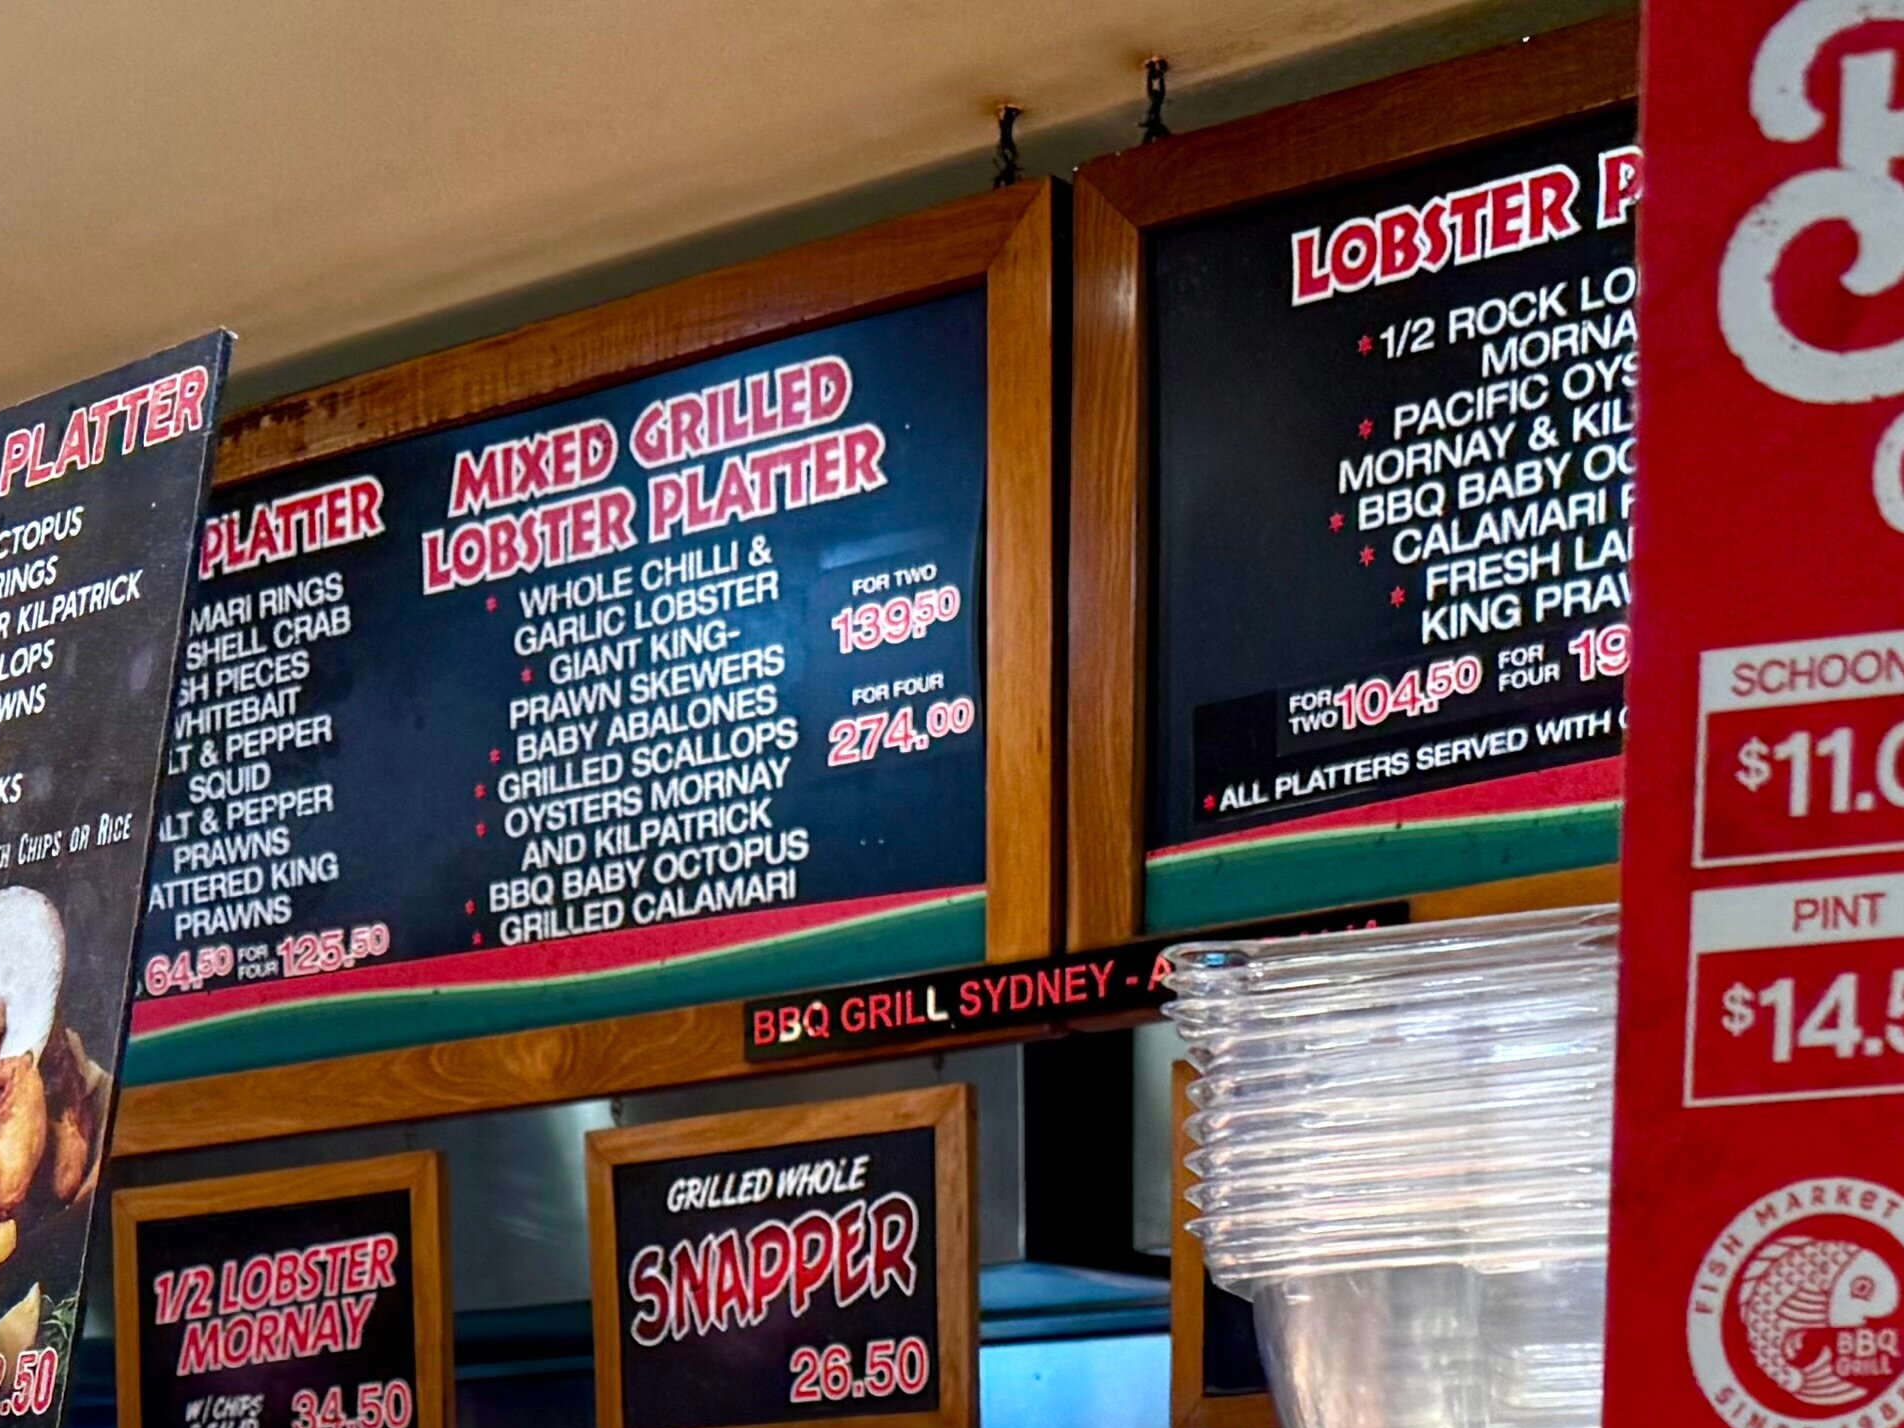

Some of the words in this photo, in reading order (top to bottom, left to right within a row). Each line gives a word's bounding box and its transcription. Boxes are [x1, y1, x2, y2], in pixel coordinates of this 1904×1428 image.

[1292, 163, 1580, 305] LOBSTER
[1379, 318, 1434, 359] 1/2
[1448, 283, 1566, 345] ROCK
[448, 420, 616, 517] MIXED
[631, 355, 852, 462] GRILLED
[1393, 374, 1549, 440] PACIFIC
[1339, 425, 1515, 494] MORNAY
[1358, 482, 1447, 532] BBQ
[1458, 453, 1570, 509] BABY
[199, 476, 385, 580] PLATTER
[422, 483, 635, 594] LOBSTER
[649, 425, 887, 543] PLATTER
[1392, 488, 1605, 564] CALAMARI
[17, 570, 142, 635] KILPATRICK
[519, 562, 636, 619] WHOLE
[642, 543, 742, 593] CHILLI
[746, 536, 773, 569] &
[1426, 537, 1560, 600] FRESH
[513, 609, 626, 657] GARLIC
[633, 572, 780, 629] LOBSTER
[830, 584, 962, 654] 139.50
[1421, 595, 1519, 645] KING
[509, 685, 623, 731] PRAWN
[629, 646, 786, 704] SKEWERS
[549, 642, 644, 685] GIANT
[1333, 657, 1482, 732] 104.50
[516, 725, 597, 765] BABY
[603, 686, 778, 749] ABALONES
[827, 696, 976, 768] 274.00
[1220, 778, 1269, 811] ALL
[1274, 752, 1409, 799] PLATTERS
[1416, 729, 1526, 772] SERVED
[1536, 709, 1610, 749] WITH
[488, 871, 553, 914] BBQ
[562, 856, 646, 899] BABY
[654, 829, 809, 884] OCTOPUS
[521, 833, 588, 872] AND
[594, 800, 773, 856] KILPATRICK
[1793, 892, 1885, 933] PINT
[752, 1002, 830, 1046] BBQ
[842, 986, 948, 1034] GRILL
[959, 960, 1116, 1017] SYDNEY
[666, 1166, 772, 1216] GRILLED
[776, 1155, 871, 1200] WHOLE
[153, 1262, 214, 1321] 1/2
[222, 1234, 399, 1316] LOBSTER
[629, 1191, 918, 1348] SNAPPER
[1694, 1234, 1744, 1314] FISH
[1755, 1185, 1900, 1227] MARKET
[177, 1296, 378, 1377] MORNAY
[789, 1336, 928, 1404] 26.50
[1837, 1329, 1900, 1358] BBQ
